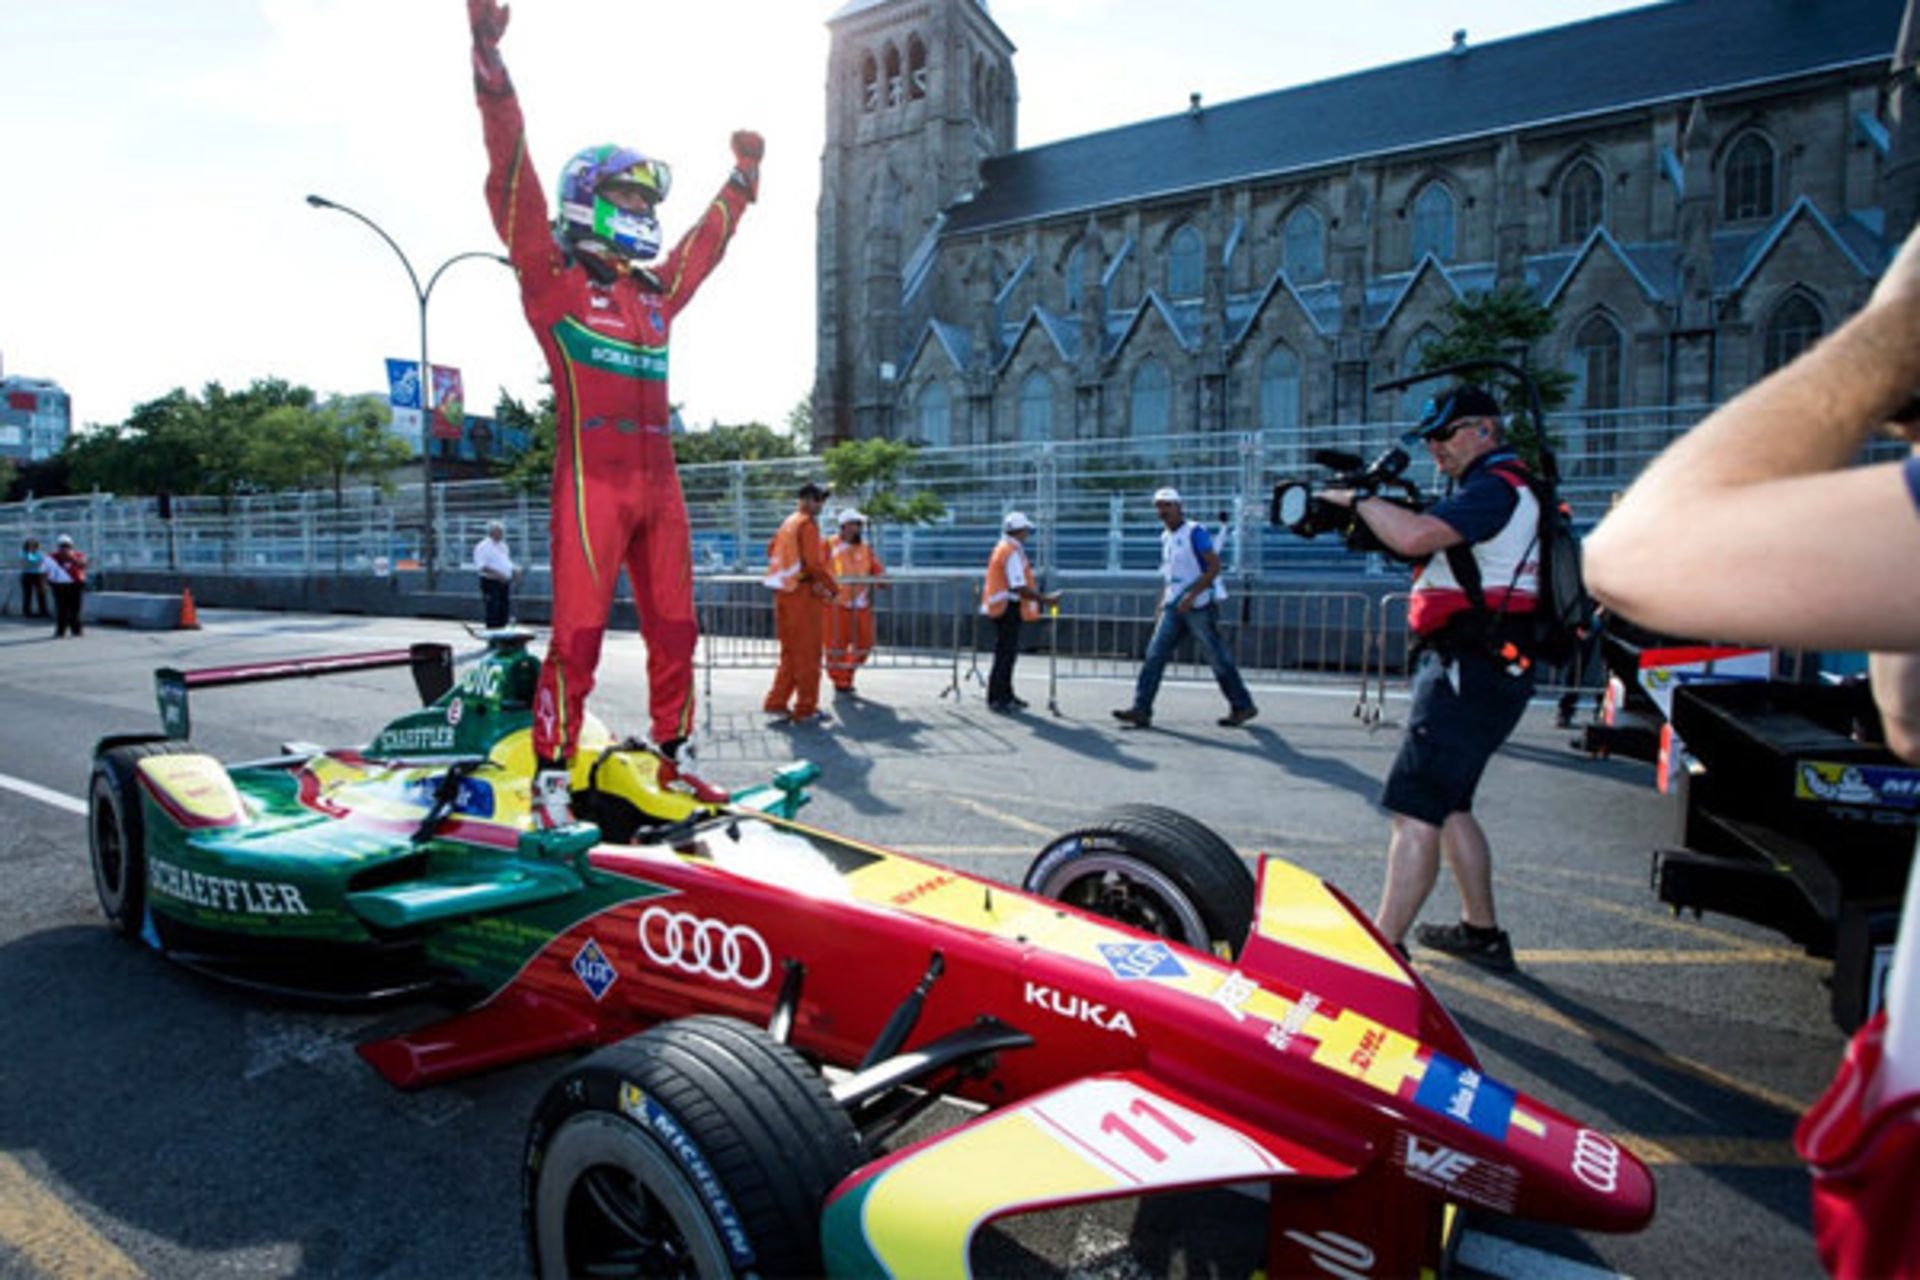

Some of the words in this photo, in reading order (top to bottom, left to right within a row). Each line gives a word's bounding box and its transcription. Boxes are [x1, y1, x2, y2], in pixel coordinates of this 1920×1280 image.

[149, 857, 309, 915] SCHAEFFLER
[1024, 982, 1137, 1038] KUKA
[1100, 1098, 1197, 1162] 11
[653, 1114, 750, 1253] MICHELIN
